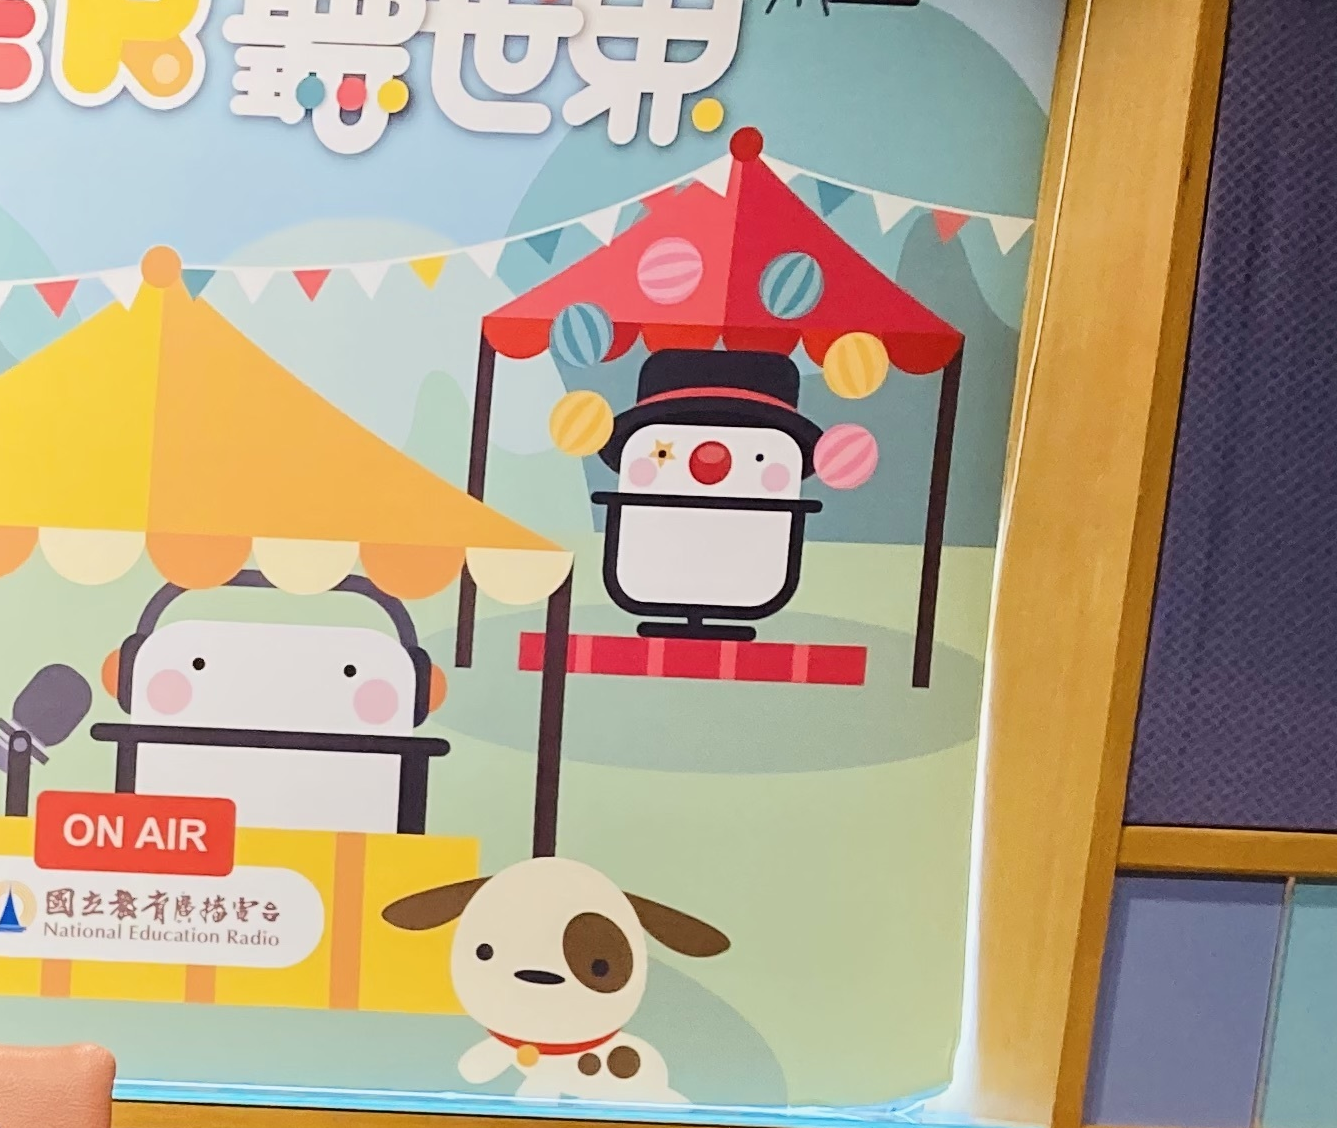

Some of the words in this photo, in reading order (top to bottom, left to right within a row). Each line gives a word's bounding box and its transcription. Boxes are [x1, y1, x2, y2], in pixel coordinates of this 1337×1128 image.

[63, 813, 124, 848] ON
[134, 816, 208, 853] AIR
[43, 921, 122, 940] National
[128, 924, 220, 945] Education
[226, 929, 280, 947] Radio
